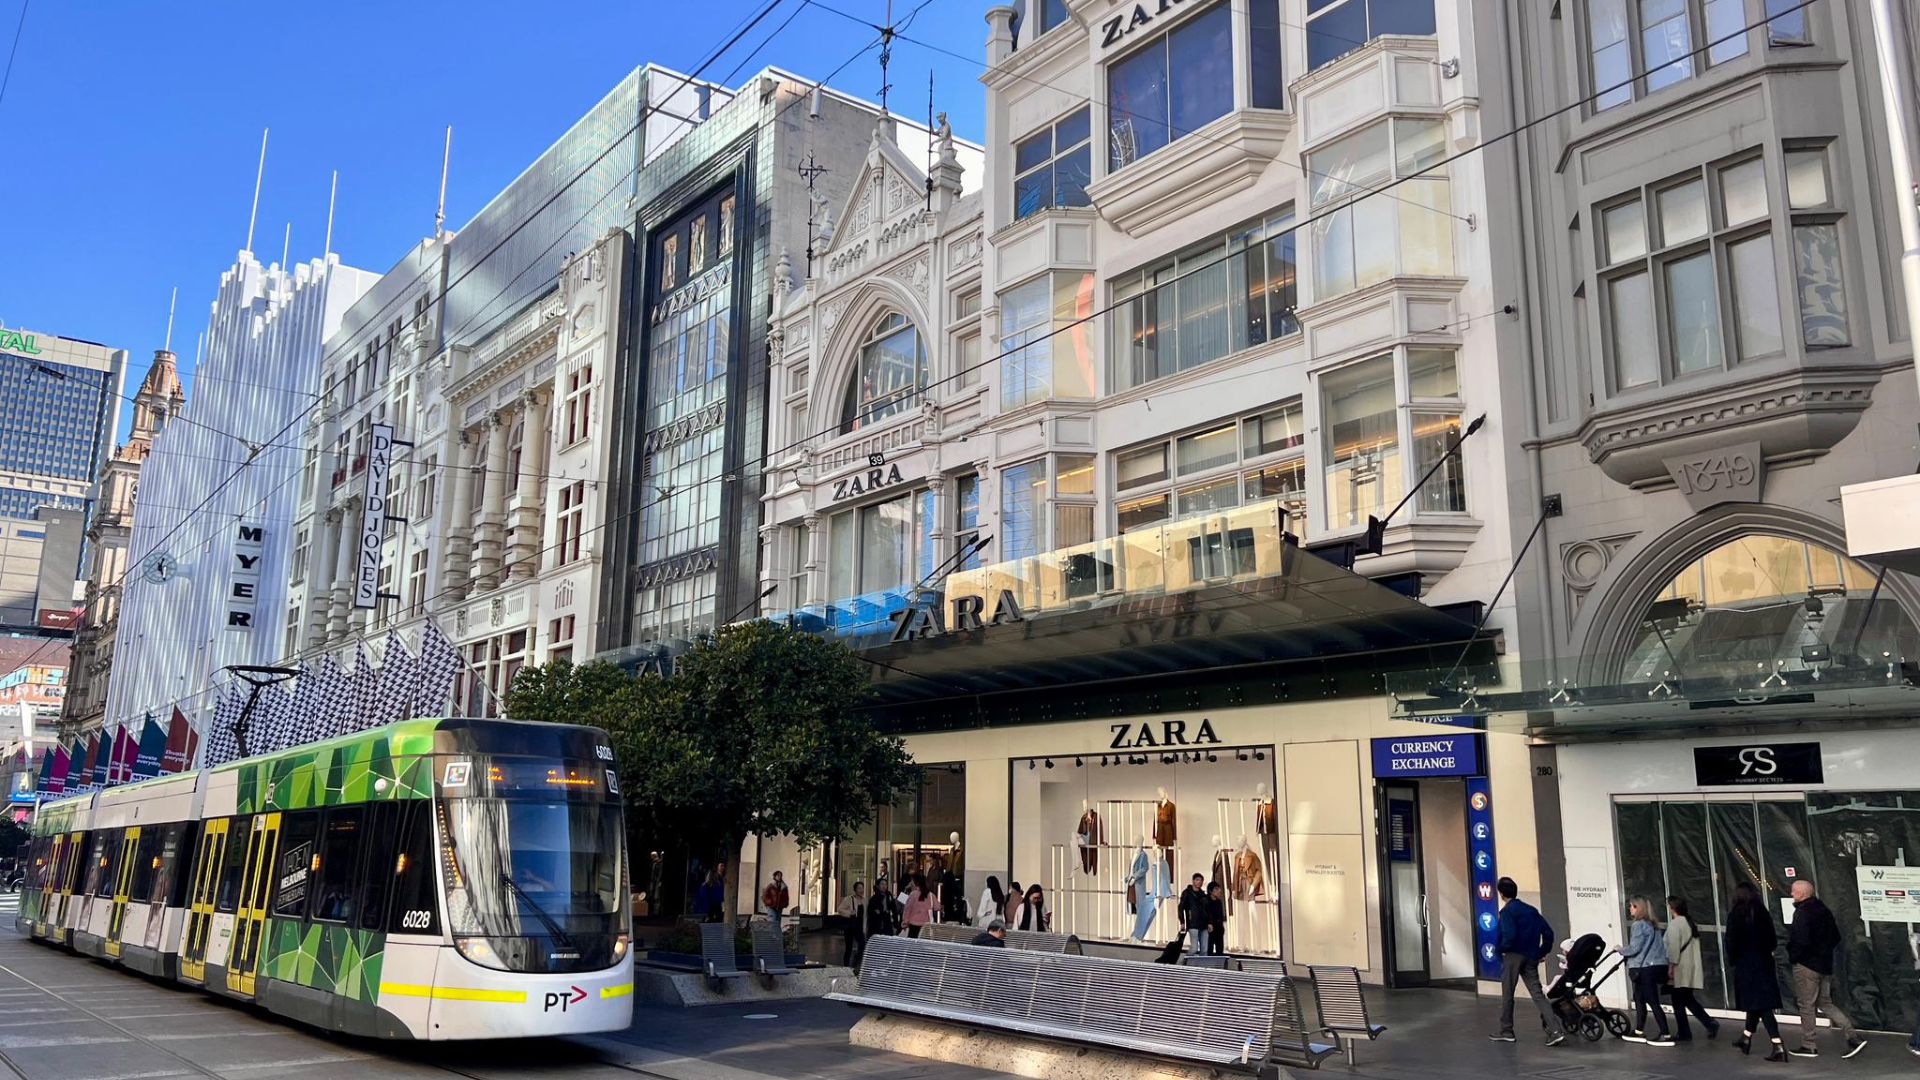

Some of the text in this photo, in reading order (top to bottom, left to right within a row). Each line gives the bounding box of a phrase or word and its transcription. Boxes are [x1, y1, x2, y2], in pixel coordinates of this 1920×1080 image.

[870, 455, 883, 466] 39
[1678, 456, 1755, 496] 1849
[832, 463, 904, 501] ZARA
[360, 435, 389, 599] DAVID JONES
[228, 525, 262, 627] MYER
[889, 589, 1024, 643] ZARA
[1110, 719, 1222, 748] ZARA
[1391, 741, 1454, 754] CURRENCY
[1392, 757, 1456, 770] EXCHANGE
[403, 910, 431, 928] 6028
